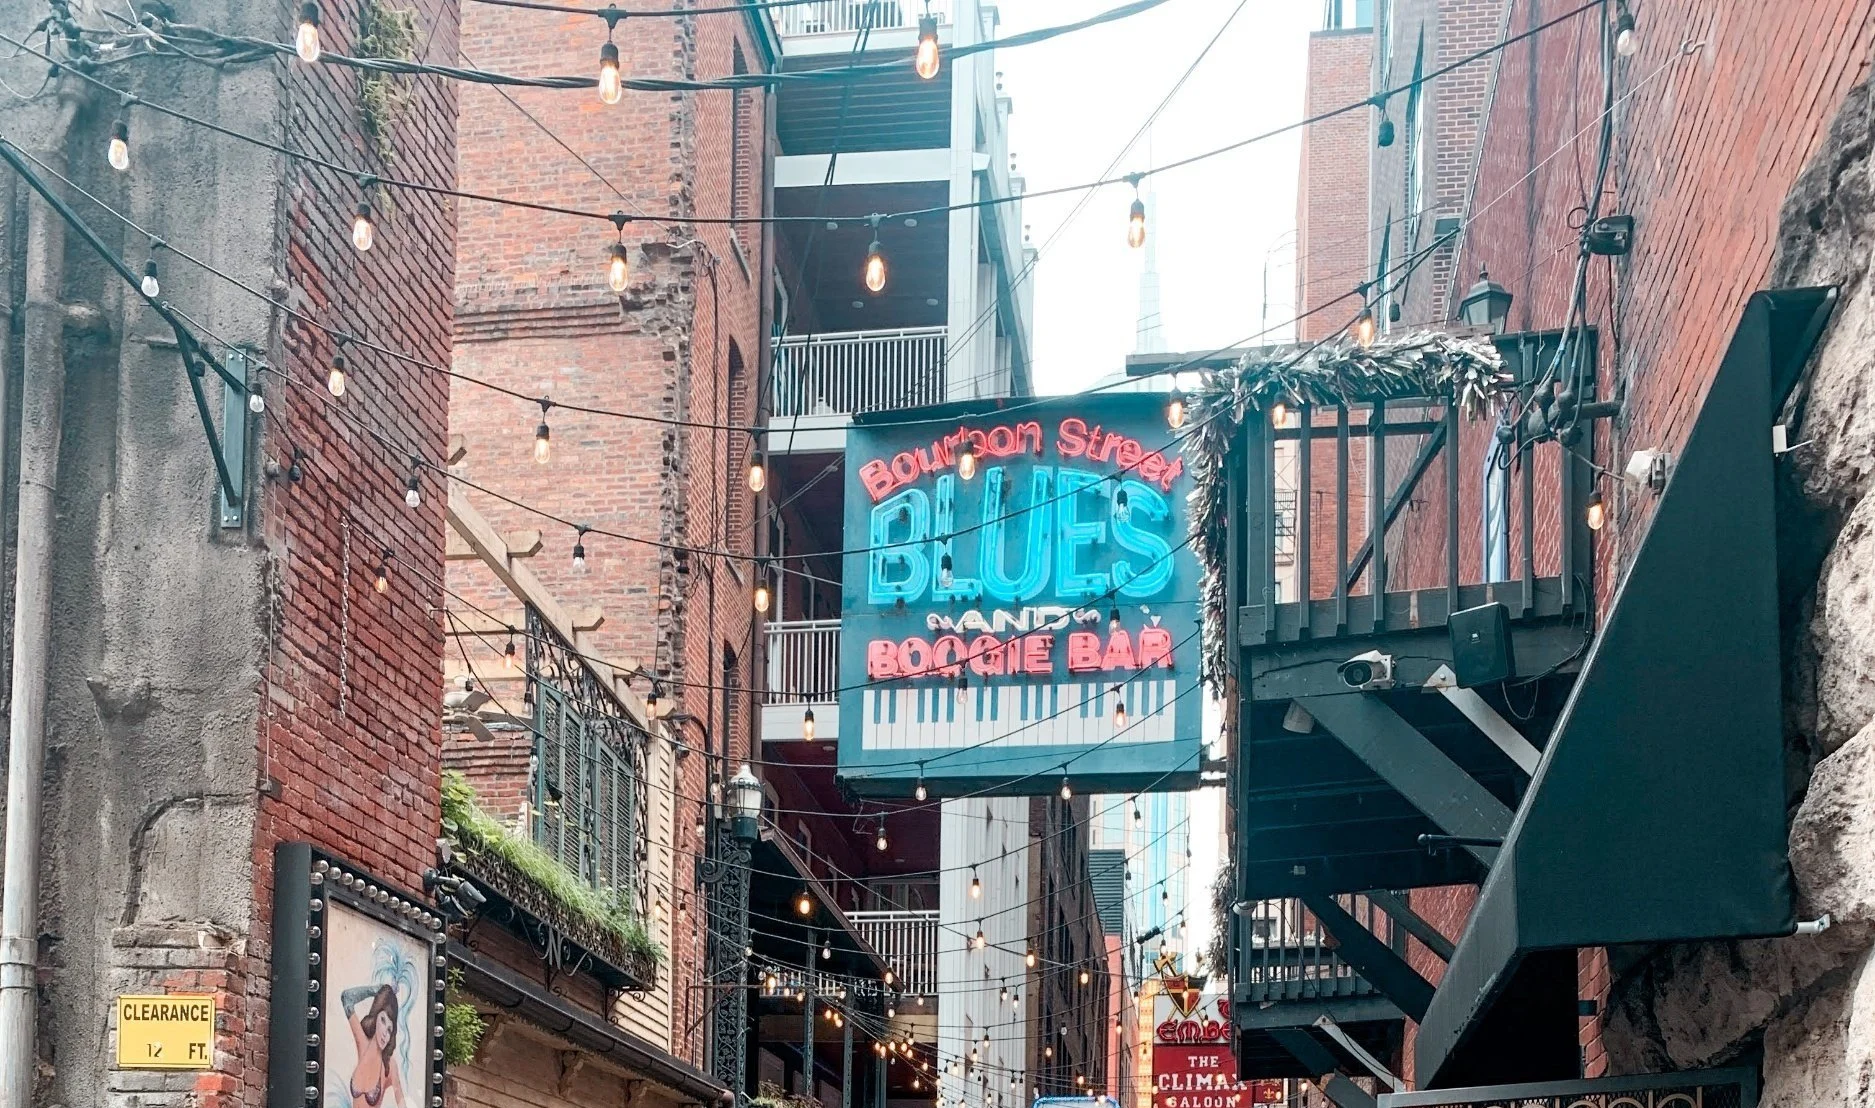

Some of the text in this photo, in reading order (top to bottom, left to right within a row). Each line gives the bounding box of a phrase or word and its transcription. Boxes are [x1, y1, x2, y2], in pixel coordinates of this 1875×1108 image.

[859, 418, 1183, 501] Bourbon Street
[868, 465, 1175, 605] BLUES
[954, 607, 1074, 633] AND
[868, 628, 1173, 679] BOOGIE BAR
[123, 1004, 209, 1021] CLEARANCE
[189, 1042, 208, 1059] FT.
[1188, 1056, 1219, 1068] THE
[1158, 1073, 1248, 1091] CLIMAX
[1169, 1096, 1237, 1108] SALOON
